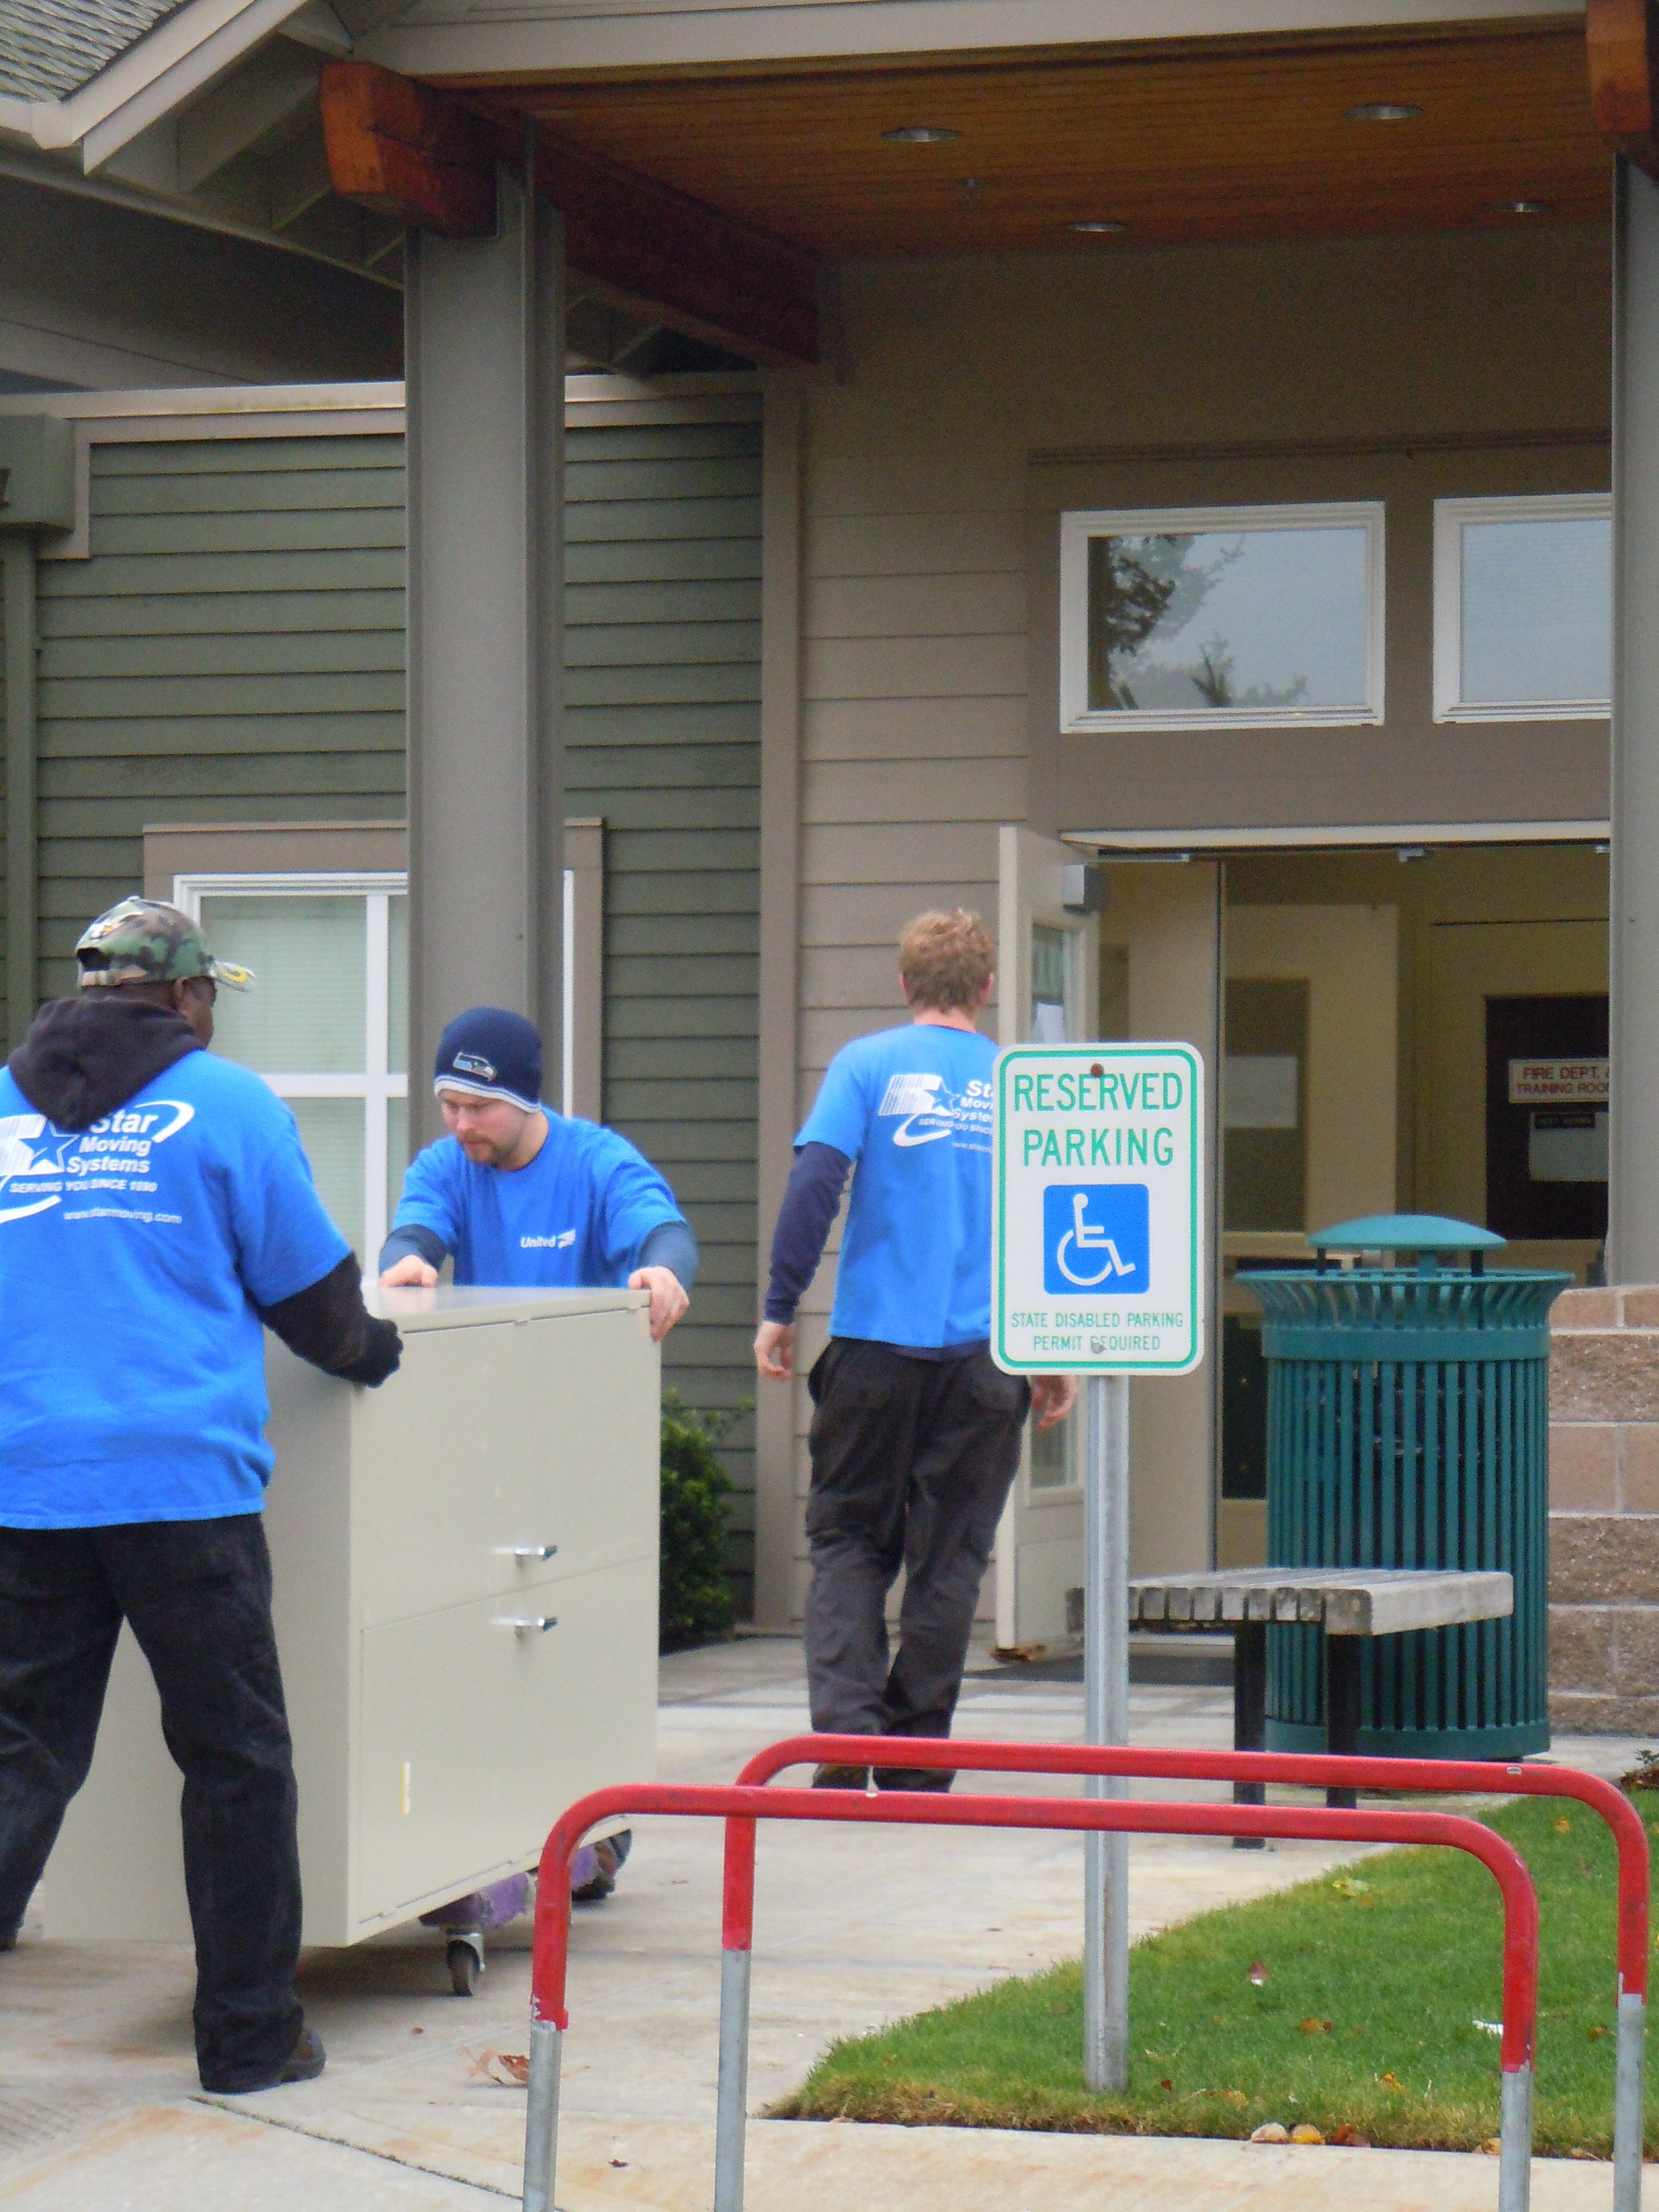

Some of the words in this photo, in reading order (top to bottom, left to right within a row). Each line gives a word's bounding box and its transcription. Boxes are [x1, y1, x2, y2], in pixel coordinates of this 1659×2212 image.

[1523, 1067, 1555, 1080] FIRE
[966, 1080, 993, 1098] St
[1014, 1073, 1183, 1111] RESERVED
[1577, 1082, 1609, 1093] ROO
[90, 1109, 159, 1134] Star
[951, 1108, 993, 1122] Syste
[79, 1136, 152, 1157] Moving
[1024, 1128, 1174, 1166] PARKING
[66, 1156, 151, 1177] Systems
[520, 1236, 556, 1248] United
[1011, 1313, 1048, 1328] STATE
[1055, 1313, 1121, 1328] DISABLED
[1127, 1312, 1183, 1327] PARKING
[1033, 1336, 1083, 1350] PERMIT
